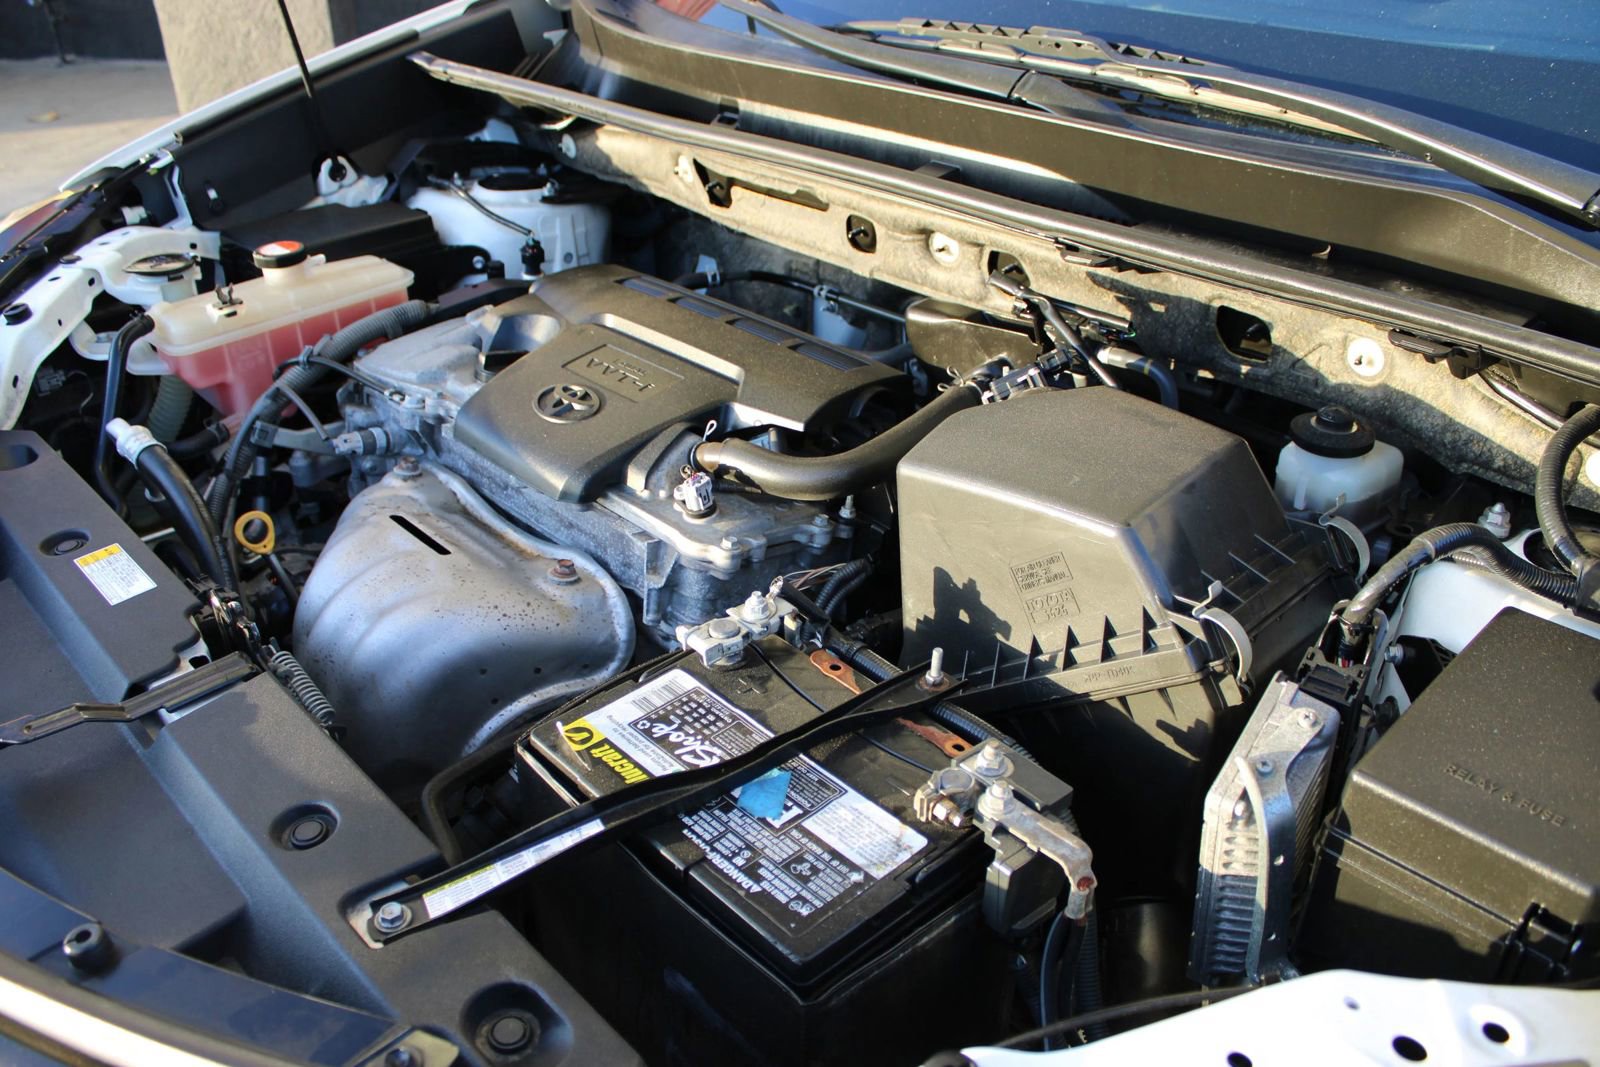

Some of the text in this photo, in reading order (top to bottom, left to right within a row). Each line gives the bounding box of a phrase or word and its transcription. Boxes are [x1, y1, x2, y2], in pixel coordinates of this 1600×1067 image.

[586, 357, 655, 392] VVT-i
[603, 714, 629, 732] recycling
[615, 731, 641, 749] batteries
[625, 729, 645, 744] proper
[652, 720, 723, 769] Shop
[636, 747, 652, 759] used
[640, 742, 652, 750] for
[590, 743, 649, 784] lucraft
[648, 756, 670, 772] Return
[1443, 763, 1565, 827] RELAY & FUSE
[717, 836, 739, 851] FLAMES
[730, 854, 747, 867] NO
[755, 866, 798, 899] EXPLOSIVE GASES
